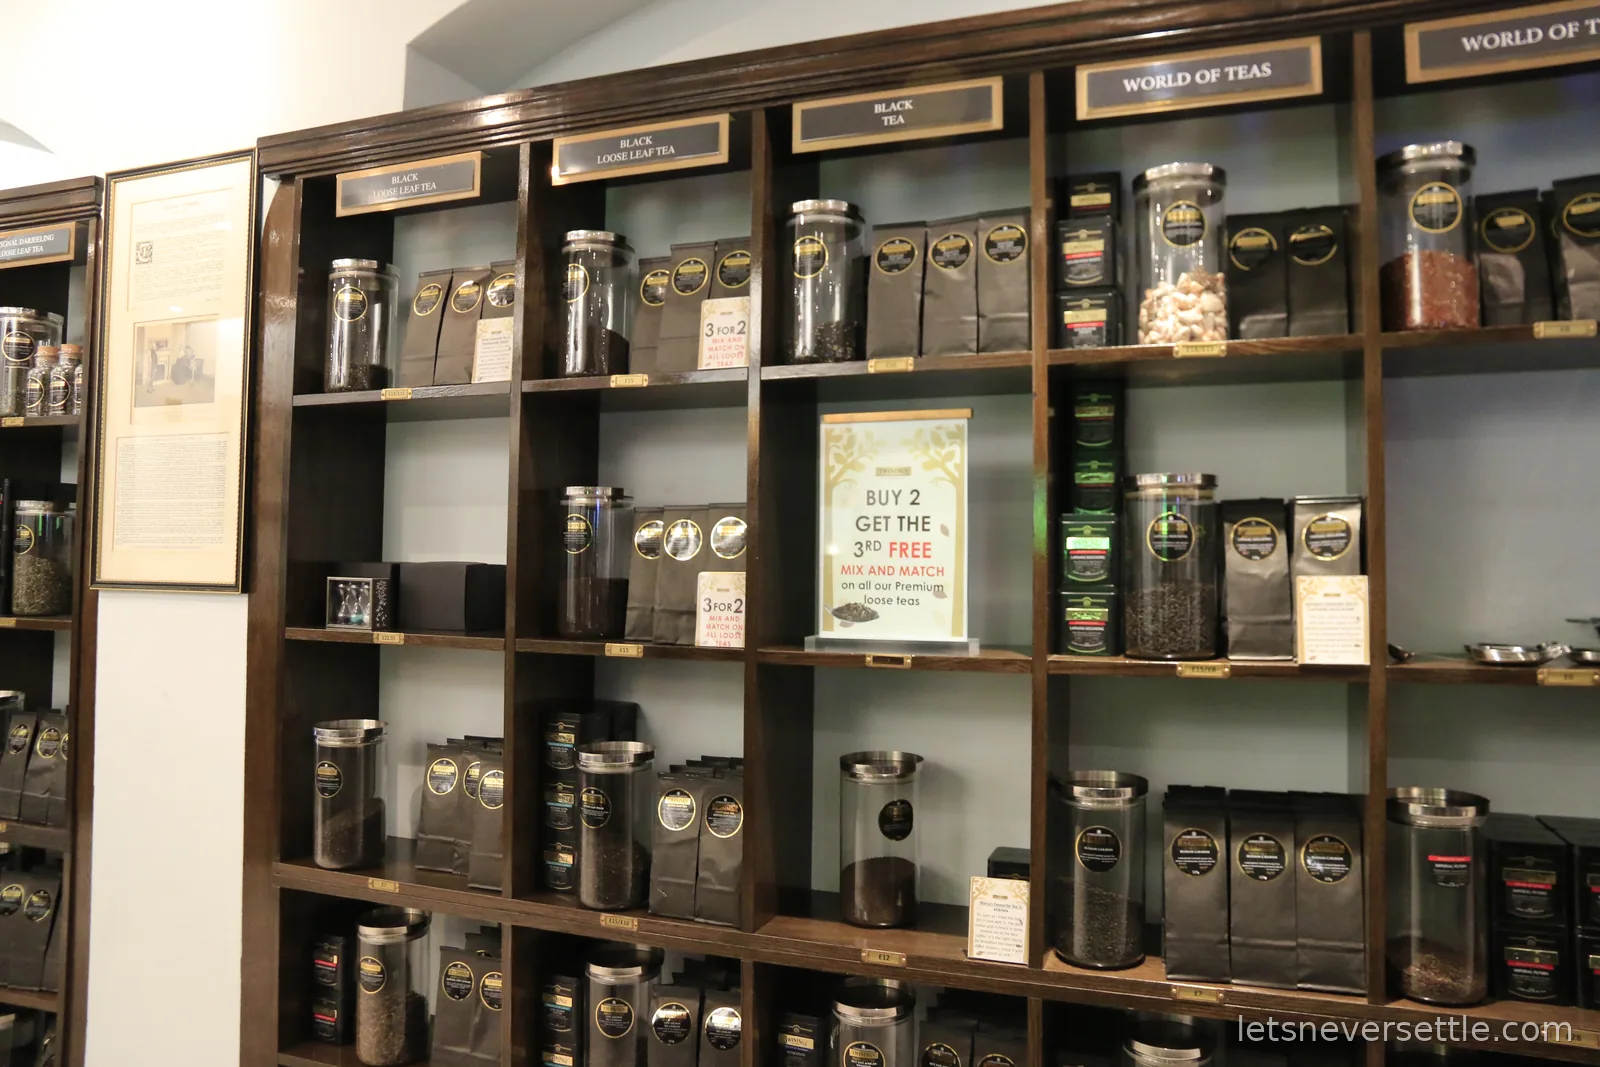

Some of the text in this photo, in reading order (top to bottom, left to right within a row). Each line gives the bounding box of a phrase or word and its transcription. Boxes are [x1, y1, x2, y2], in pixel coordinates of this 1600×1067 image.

[1461, 27, 1544, 52] WORLD
[1548, 21, 1580, 41] OF
[1122, 62, 1272, 92] WORLD OF TEAS
[874, 99, 914, 114] BLACK
[881, 114, 905, 126] TEA
[620, 136, 653, 148] BLACK
[597, 145, 676, 164] LOOSE LEAF TEA
[391, 172, 418, 184] BLACK
[372, 182, 437, 199] LOOSE LEAF TEA
[20, 234, 54, 246] DARJEELING
[0, 248, 16, 258] OOSE
[17, 247, 31, 255] LEAF
[705, 320, 746, 337] 3 FOR 2
[866, 488, 921, 506] BUY 2
[855, 515, 931, 532] GET THE
[853, 540, 932, 559] 3RD FREE
[840, 565, 944, 577] MIX AND MATCH
[841, 580, 944, 592] on all our Premium
[703, 598, 743, 614] 3 FOR 2
[864, 594, 920, 606] loose teas
[609, 918, 630, 926] £15/£10
